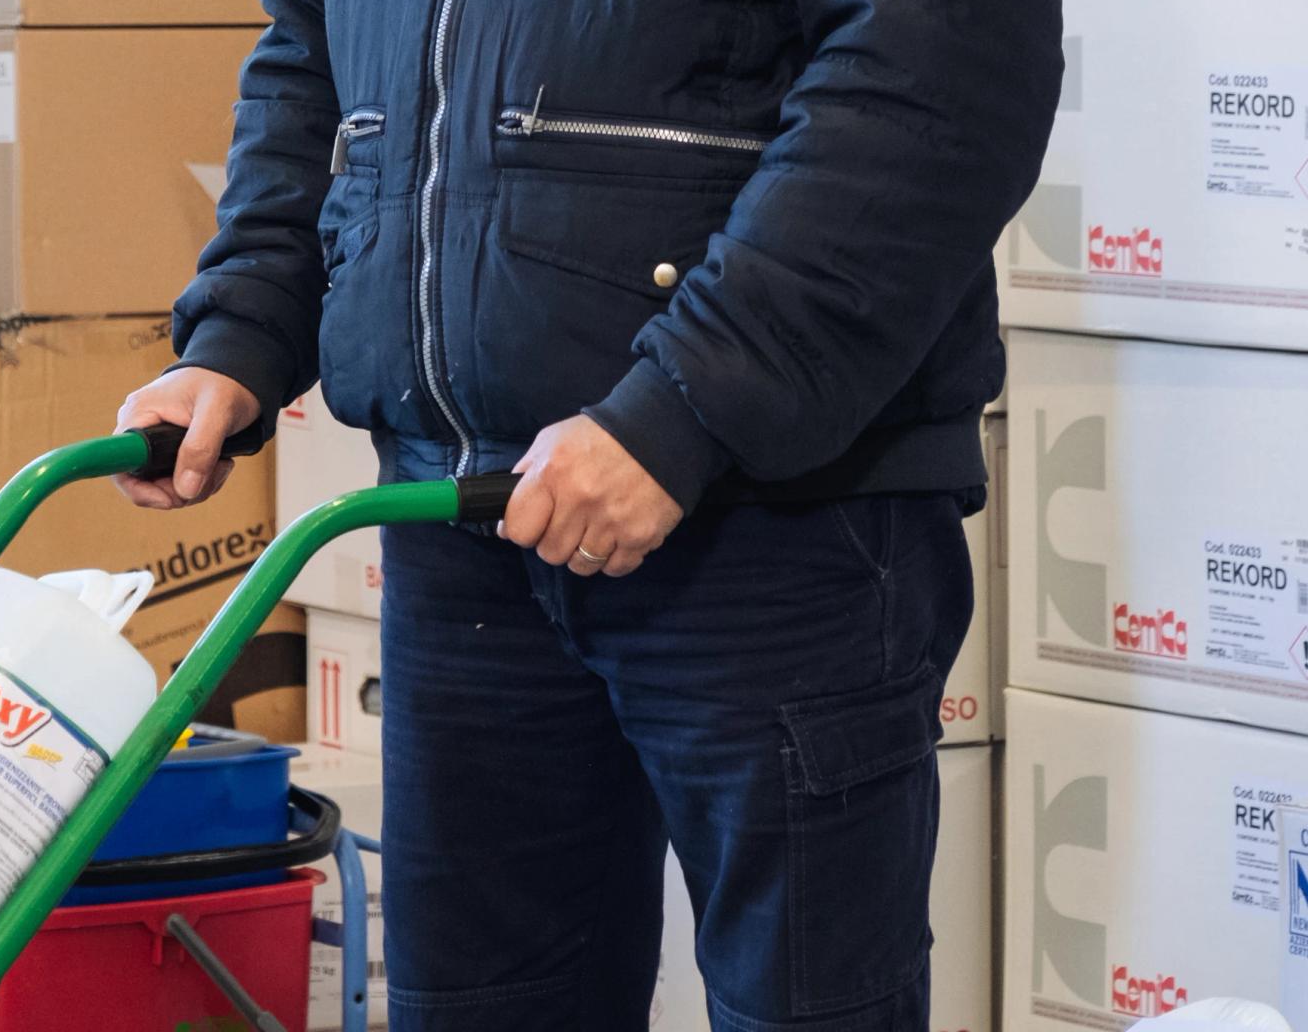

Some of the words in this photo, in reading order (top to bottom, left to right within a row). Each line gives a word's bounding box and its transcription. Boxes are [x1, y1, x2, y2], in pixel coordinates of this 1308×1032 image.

[1210, 92, 1295, 118] REKORD
[1206, 559, 1288, 590] REKORD
[1235, 804, 1276, 832] REK
